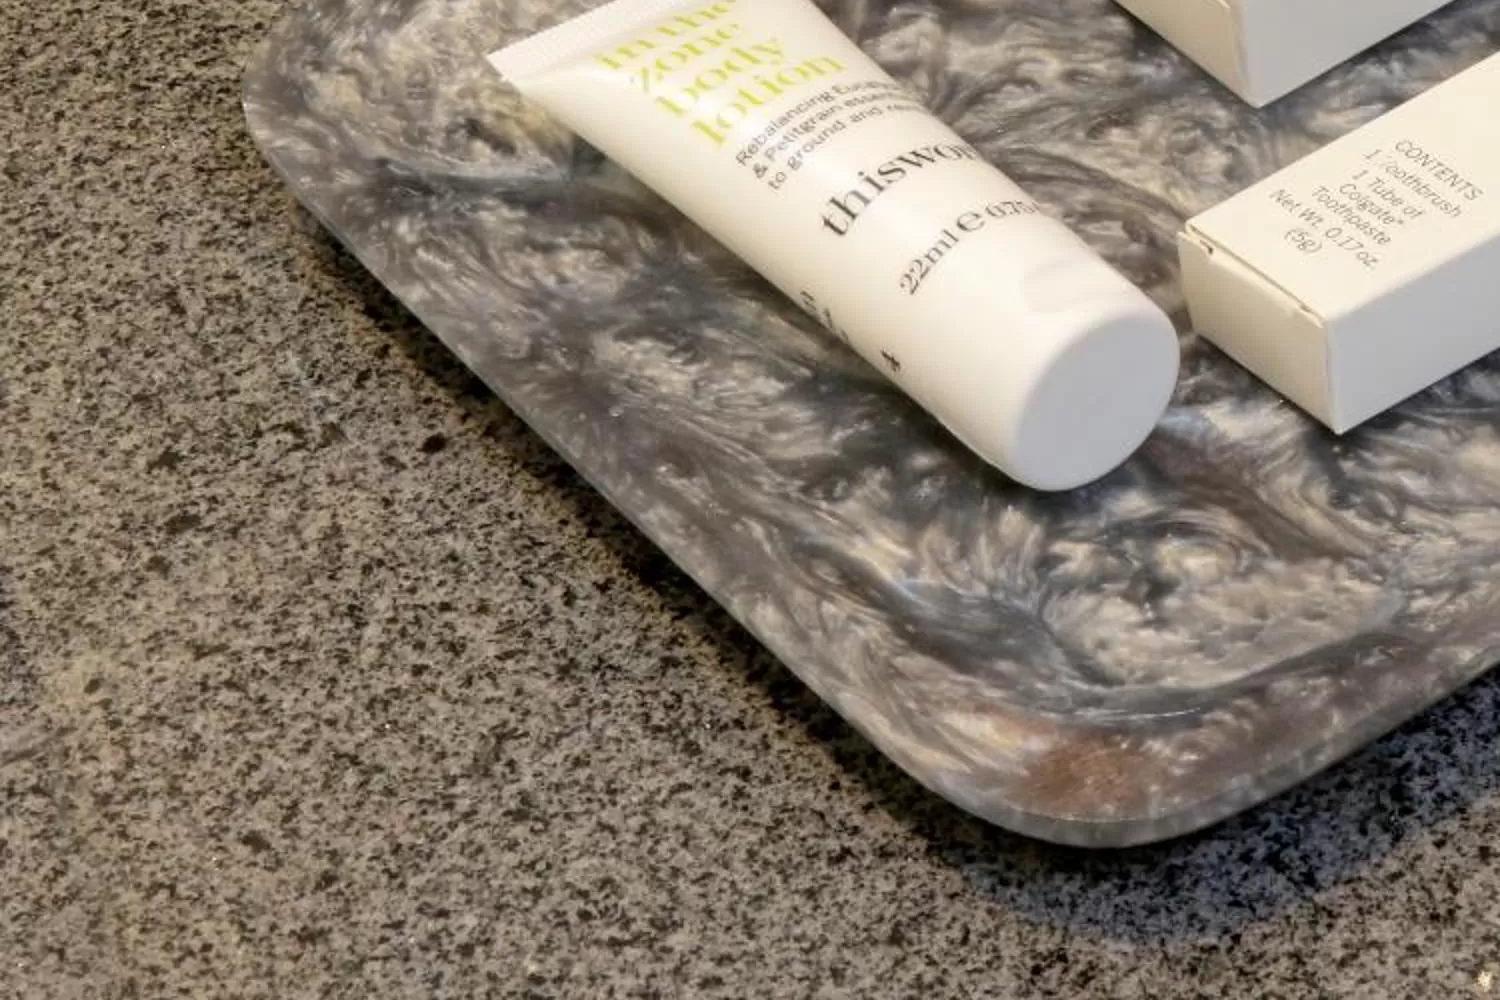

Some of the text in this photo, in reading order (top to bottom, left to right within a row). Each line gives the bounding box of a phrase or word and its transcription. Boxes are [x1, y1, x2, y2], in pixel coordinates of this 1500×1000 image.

[767, 171, 788, 190] to
[787, 118, 847, 171] ground
[1394, 138, 1484, 201] CONTENTS
[1269, 188, 1301, 214] Net
[1324, 226, 1365, 251] 0.17
[1311, 184, 1391, 246] Toothpaste
[1367, 176, 1405, 207] Tube
[1402, 205, 1426, 220] of
[899, 228, 960, 296] 22ml
[1283, 227, 1323, 255] (5g)
